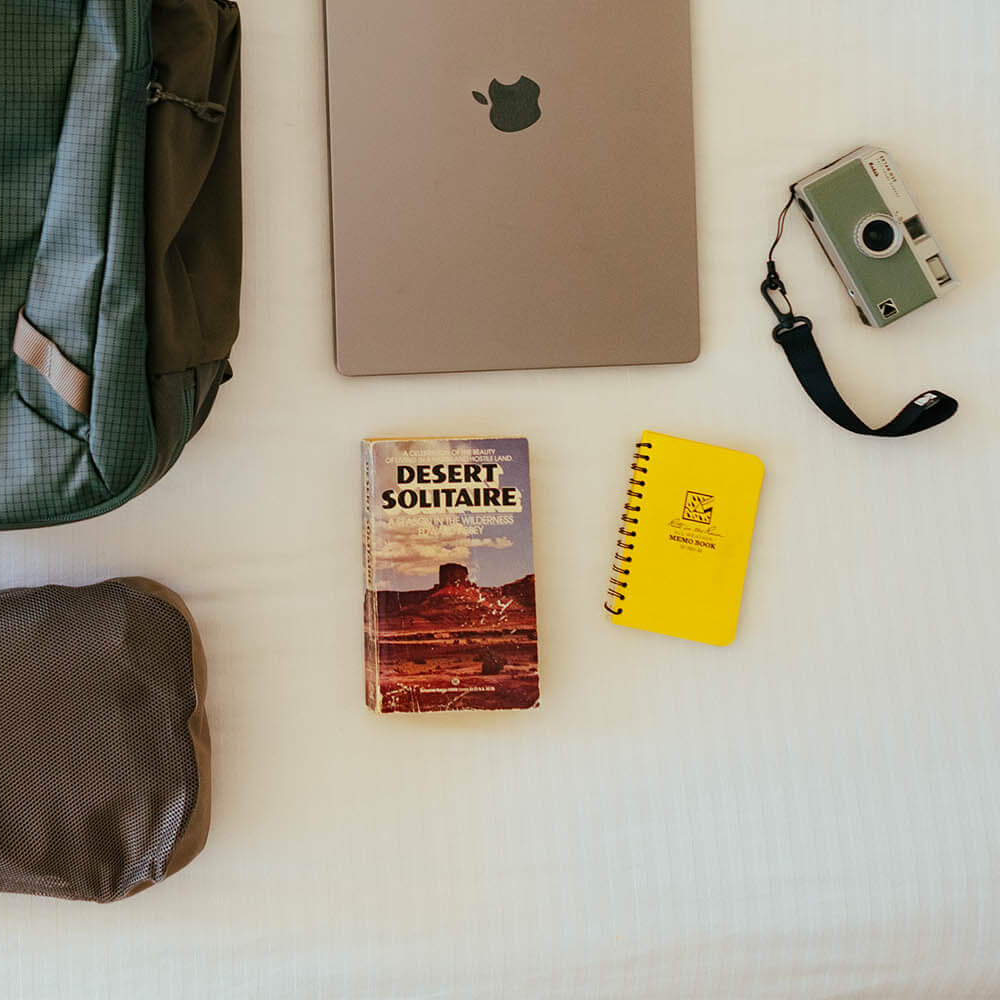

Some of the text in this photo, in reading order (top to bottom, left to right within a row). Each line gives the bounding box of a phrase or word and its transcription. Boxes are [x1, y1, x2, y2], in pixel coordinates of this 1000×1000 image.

[397, 463, 498, 485] DESERT
[381, 487, 517, 510] SOLITAIRE
[461, 514, 514, 526] WILDERNESS
[669, 534, 694, 545] MEMO
[694, 539, 717, 550] BOOK
